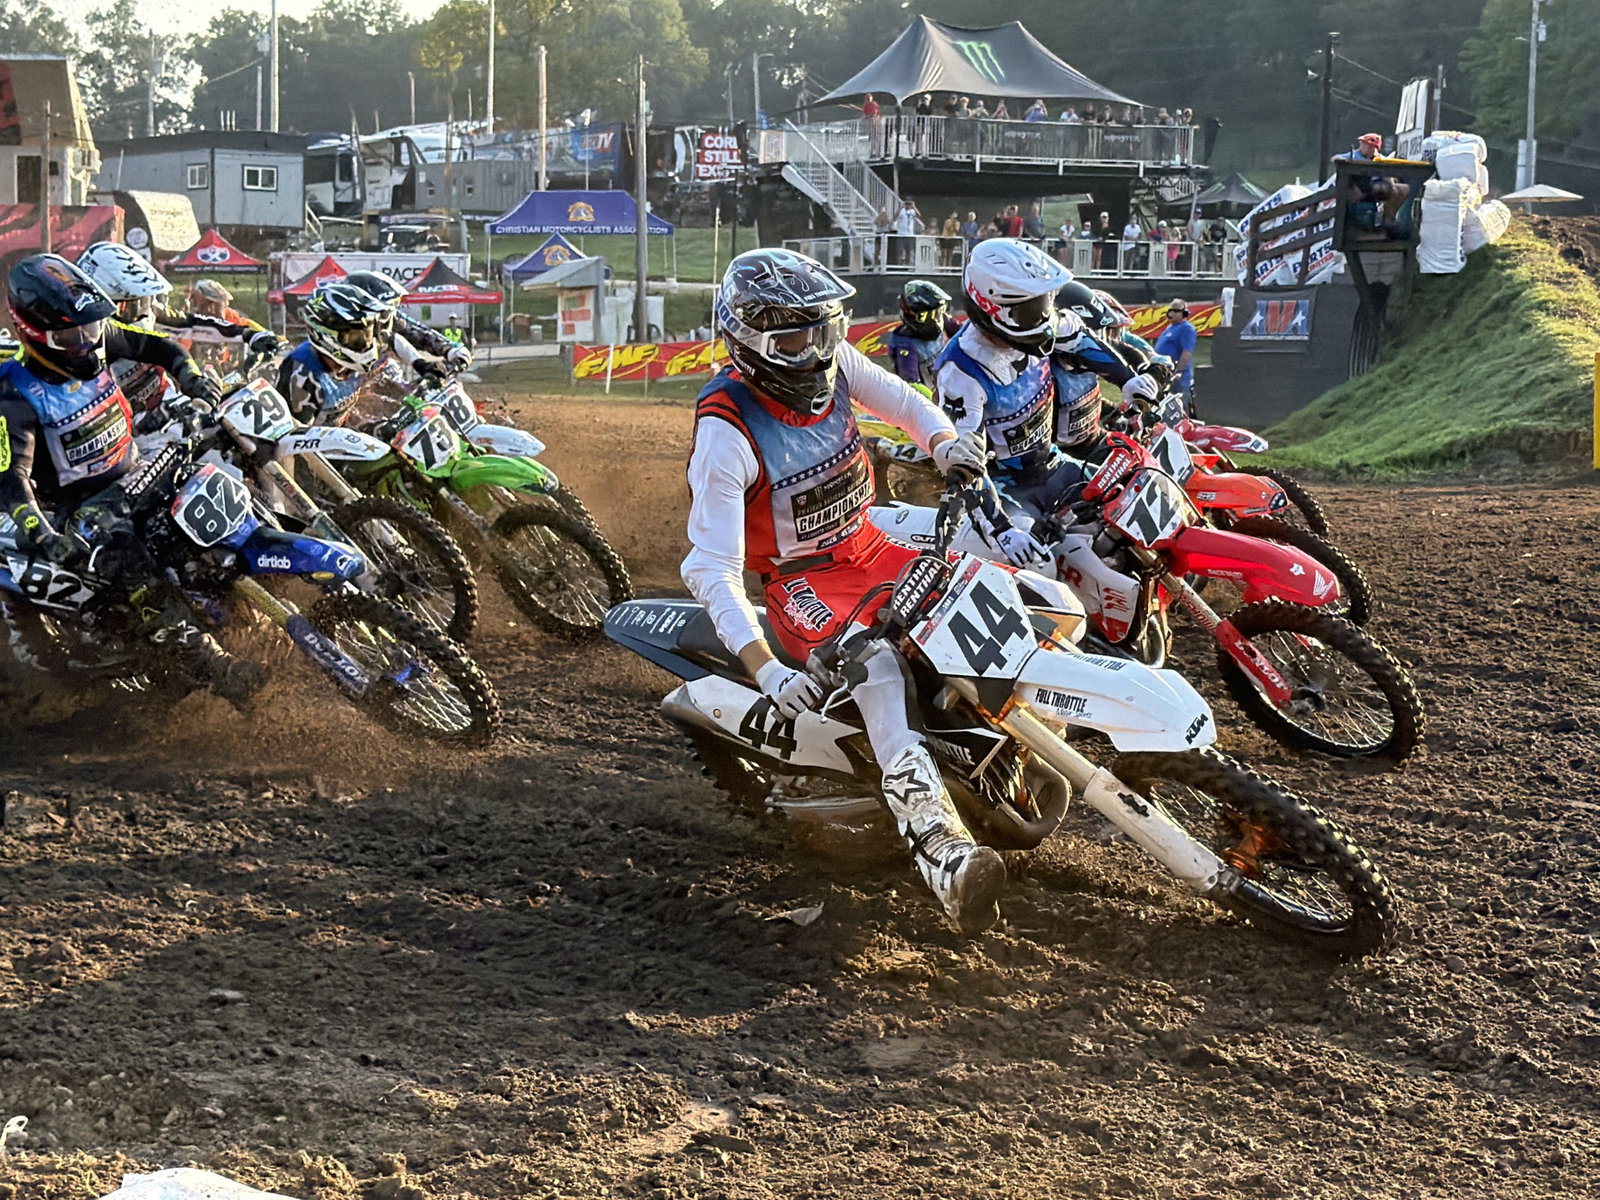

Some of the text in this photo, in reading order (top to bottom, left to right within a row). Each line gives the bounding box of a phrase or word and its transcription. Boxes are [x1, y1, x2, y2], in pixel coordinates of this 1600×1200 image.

[705, 150, 741, 163] STILL
[496, 225, 541, 234] CHRISTIAN
[542, 225, 611, 234] MOTORCYCLISTS
[382, 267, 425, 281] RACE
[418, 284, 459, 293] RACER
[574, 343, 658, 379] FMF
[242, 390, 286, 435] 29
[69, 417, 127, 460] CHAMPIONSHIP
[293, 438, 321, 450] FXR
[408, 416, 453, 471] 73
[1097, 453, 1126, 489] RENTHAL
[184, 472, 249, 545] 82
[800, 479, 873, 532] CHAMPIONSHIP
[1126, 477, 1180, 546] 12
[257, 554, 291, 569] dirtlab
[19, 563, 82, 604] 82
[900, 562, 943, 618] RENTHAL
[947, 580, 1029, 677] 44
[1035, 688, 1088, 713] FULL THROTTLE
[738, 696, 798, 761] 44
[1184, 713, 1209, 745] KTM
